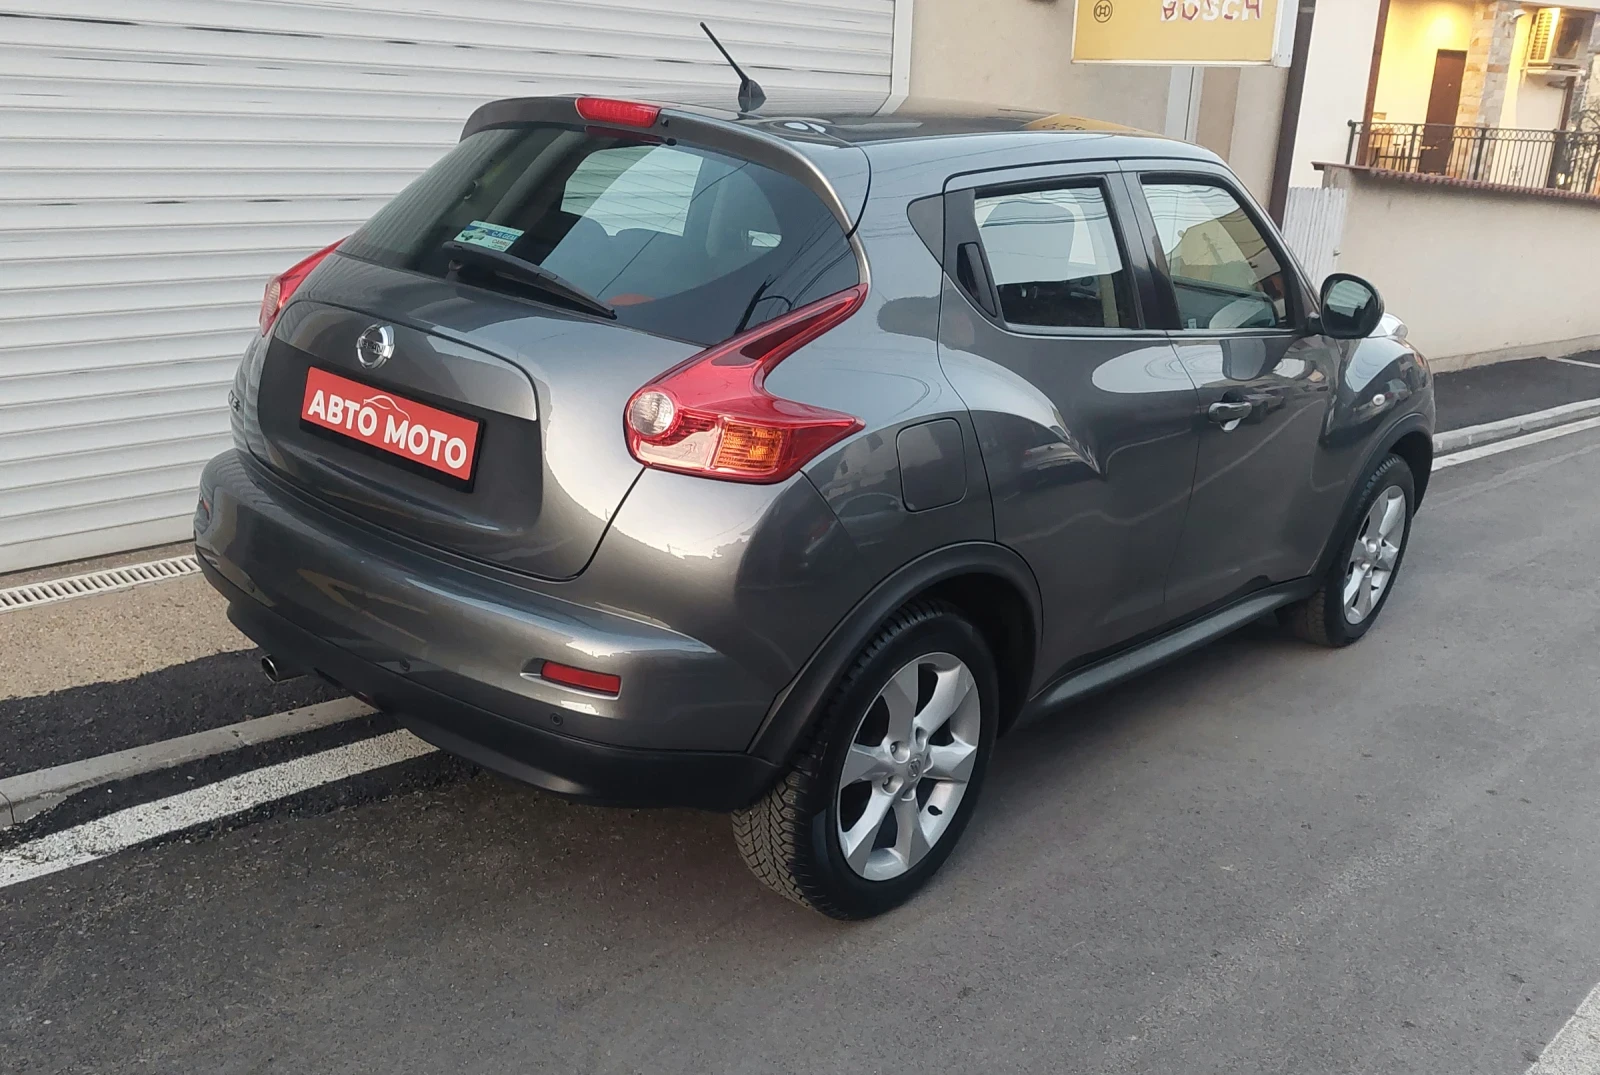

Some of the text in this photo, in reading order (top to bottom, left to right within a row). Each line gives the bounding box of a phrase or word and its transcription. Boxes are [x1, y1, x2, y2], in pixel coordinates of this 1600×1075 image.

[1161, 0, 1262, 21] BOSCH
[307, 389, 467, 469] АВТО МОТО
